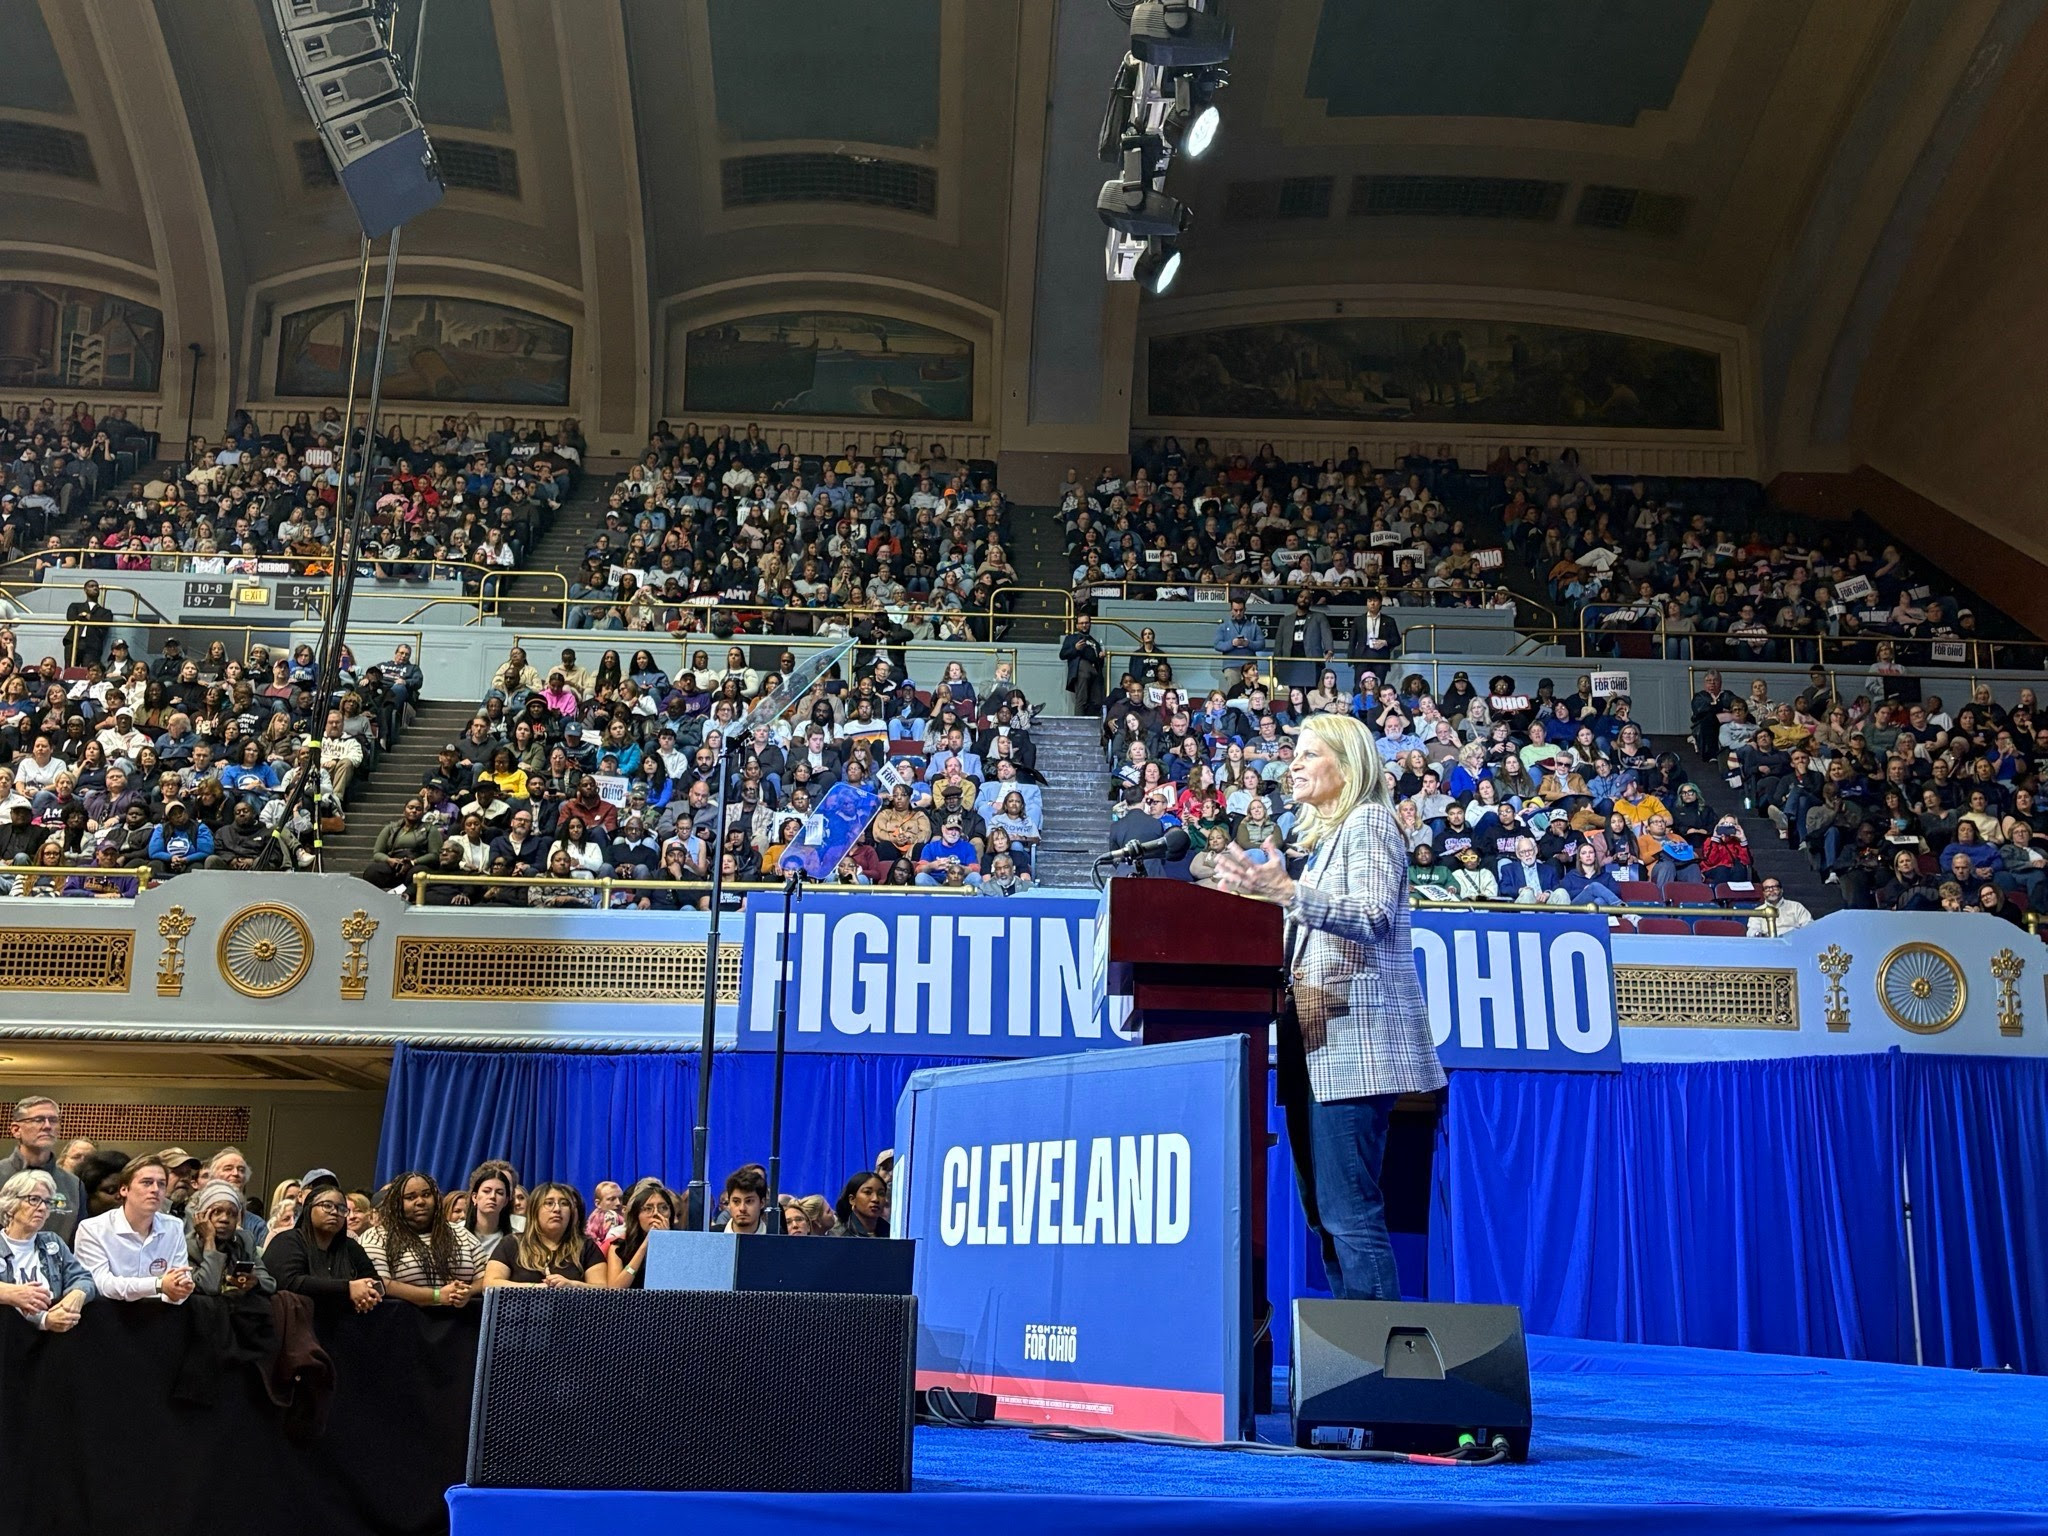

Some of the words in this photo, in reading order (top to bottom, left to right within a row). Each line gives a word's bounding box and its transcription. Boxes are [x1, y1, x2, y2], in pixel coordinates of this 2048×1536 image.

[257, 562, 290, 573] SHERROD
[197, 583, 223, 593] 10-8
[244, 590, 262, 600] EXIT
[725, 588, 752, 601] AMY
[1197, 592, 1210, 601] FOR
[1211, 592, 1226, 601] OHIO
[194, 597, 214, 606] 9-7
[1935, 645, 1947, 656] FOR
[1946, 646, 1963, 657] OHIO
[1594, 681, 1609, 691] FOR
[1610, 680, 1628, 691] OHIO
[1491, 696, 1529, 710] OHIO
[881, 769, 897, 786] FOR
[602, 787, 624, 801] OHIO
[750, 912, 1132, 1041] FIGHTIN
[940, 1132, 1191, 1247] CLEVELAND
[1025, 1324, 1077, 1335] FIGHTING
[1024, 1333, 1047, 1361] FOR
[1047, 1334, 1077, 1363] OHIO
